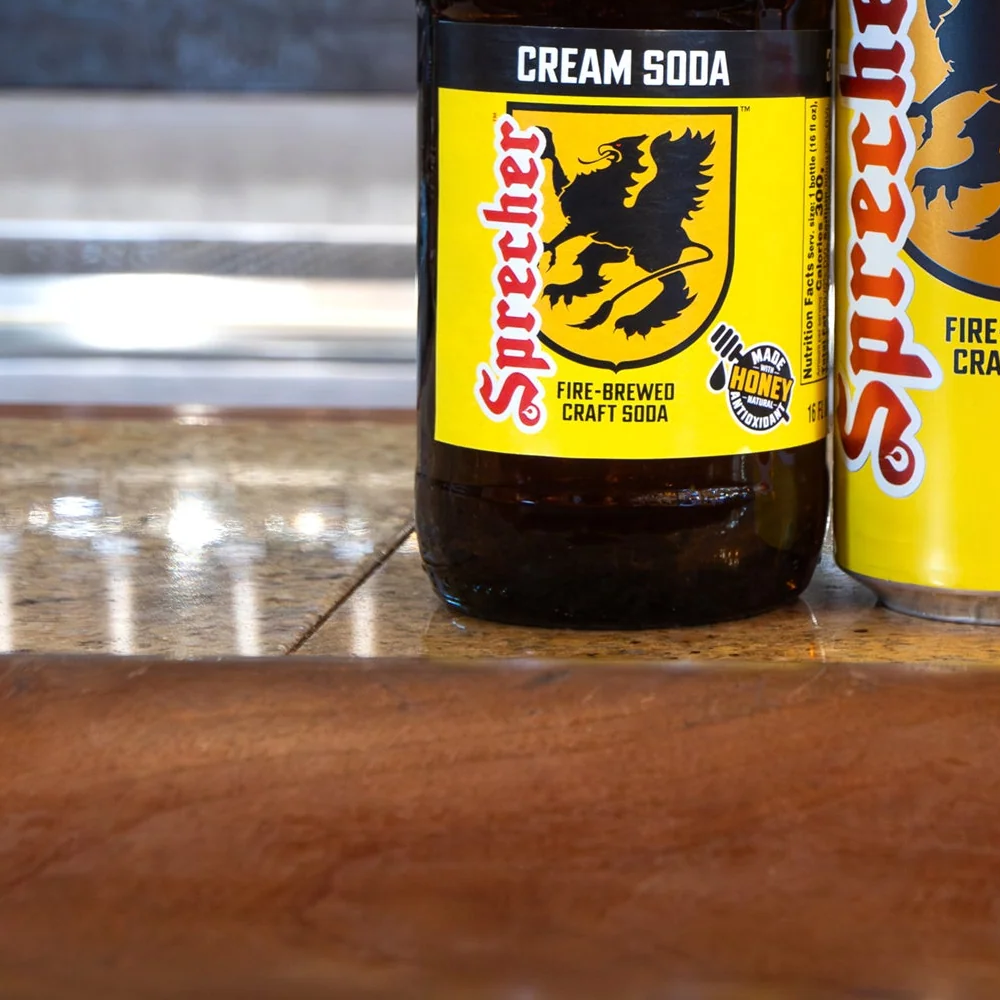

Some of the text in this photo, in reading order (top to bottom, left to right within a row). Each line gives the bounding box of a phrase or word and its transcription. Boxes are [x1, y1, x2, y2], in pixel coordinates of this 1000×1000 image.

[517, 45, 730, 86] CREAM SODA
[479, 117, 553, 431] Sprecher
[804, 263, 814, 307] Facts
[751, 347, 786, 371] MADE
[803, 311, 813, 379] Nutrition
[557, 381, 675, 400] FIRE-BREWED
[729, 365, 794, 402] HONEY
[747, 395, 773, 409] NATURAL
[562, 404, 669, 423] CRAFT SODA
[729, 391, 785, 429] ANTIOXIDANT
